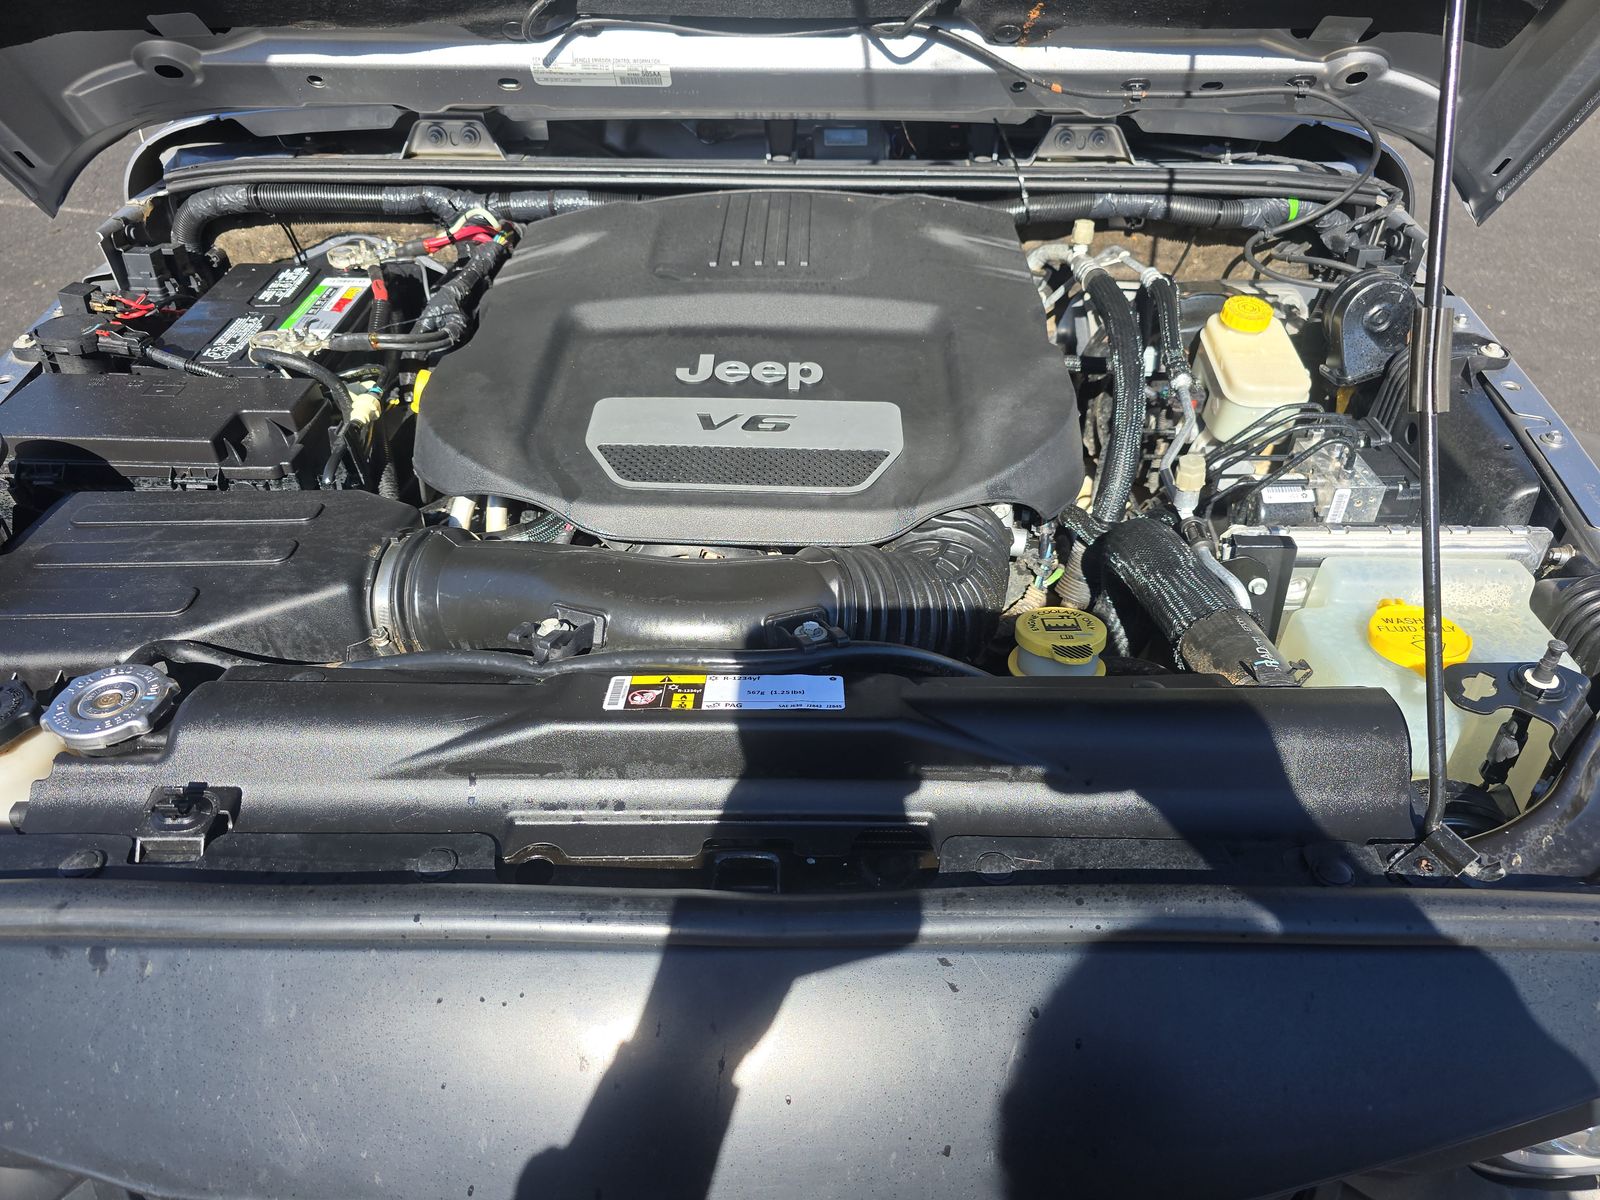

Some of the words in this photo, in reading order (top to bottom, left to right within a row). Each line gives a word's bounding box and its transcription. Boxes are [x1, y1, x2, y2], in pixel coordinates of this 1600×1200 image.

[675, 353, 824, 391] Jeep
[696, 412, 798, 432] V6
[1037, 609, 1083, 618] COOLANT
[1082, 617, 1096, 630] ONLY
[1381, 617, 1425, 625] WASH
